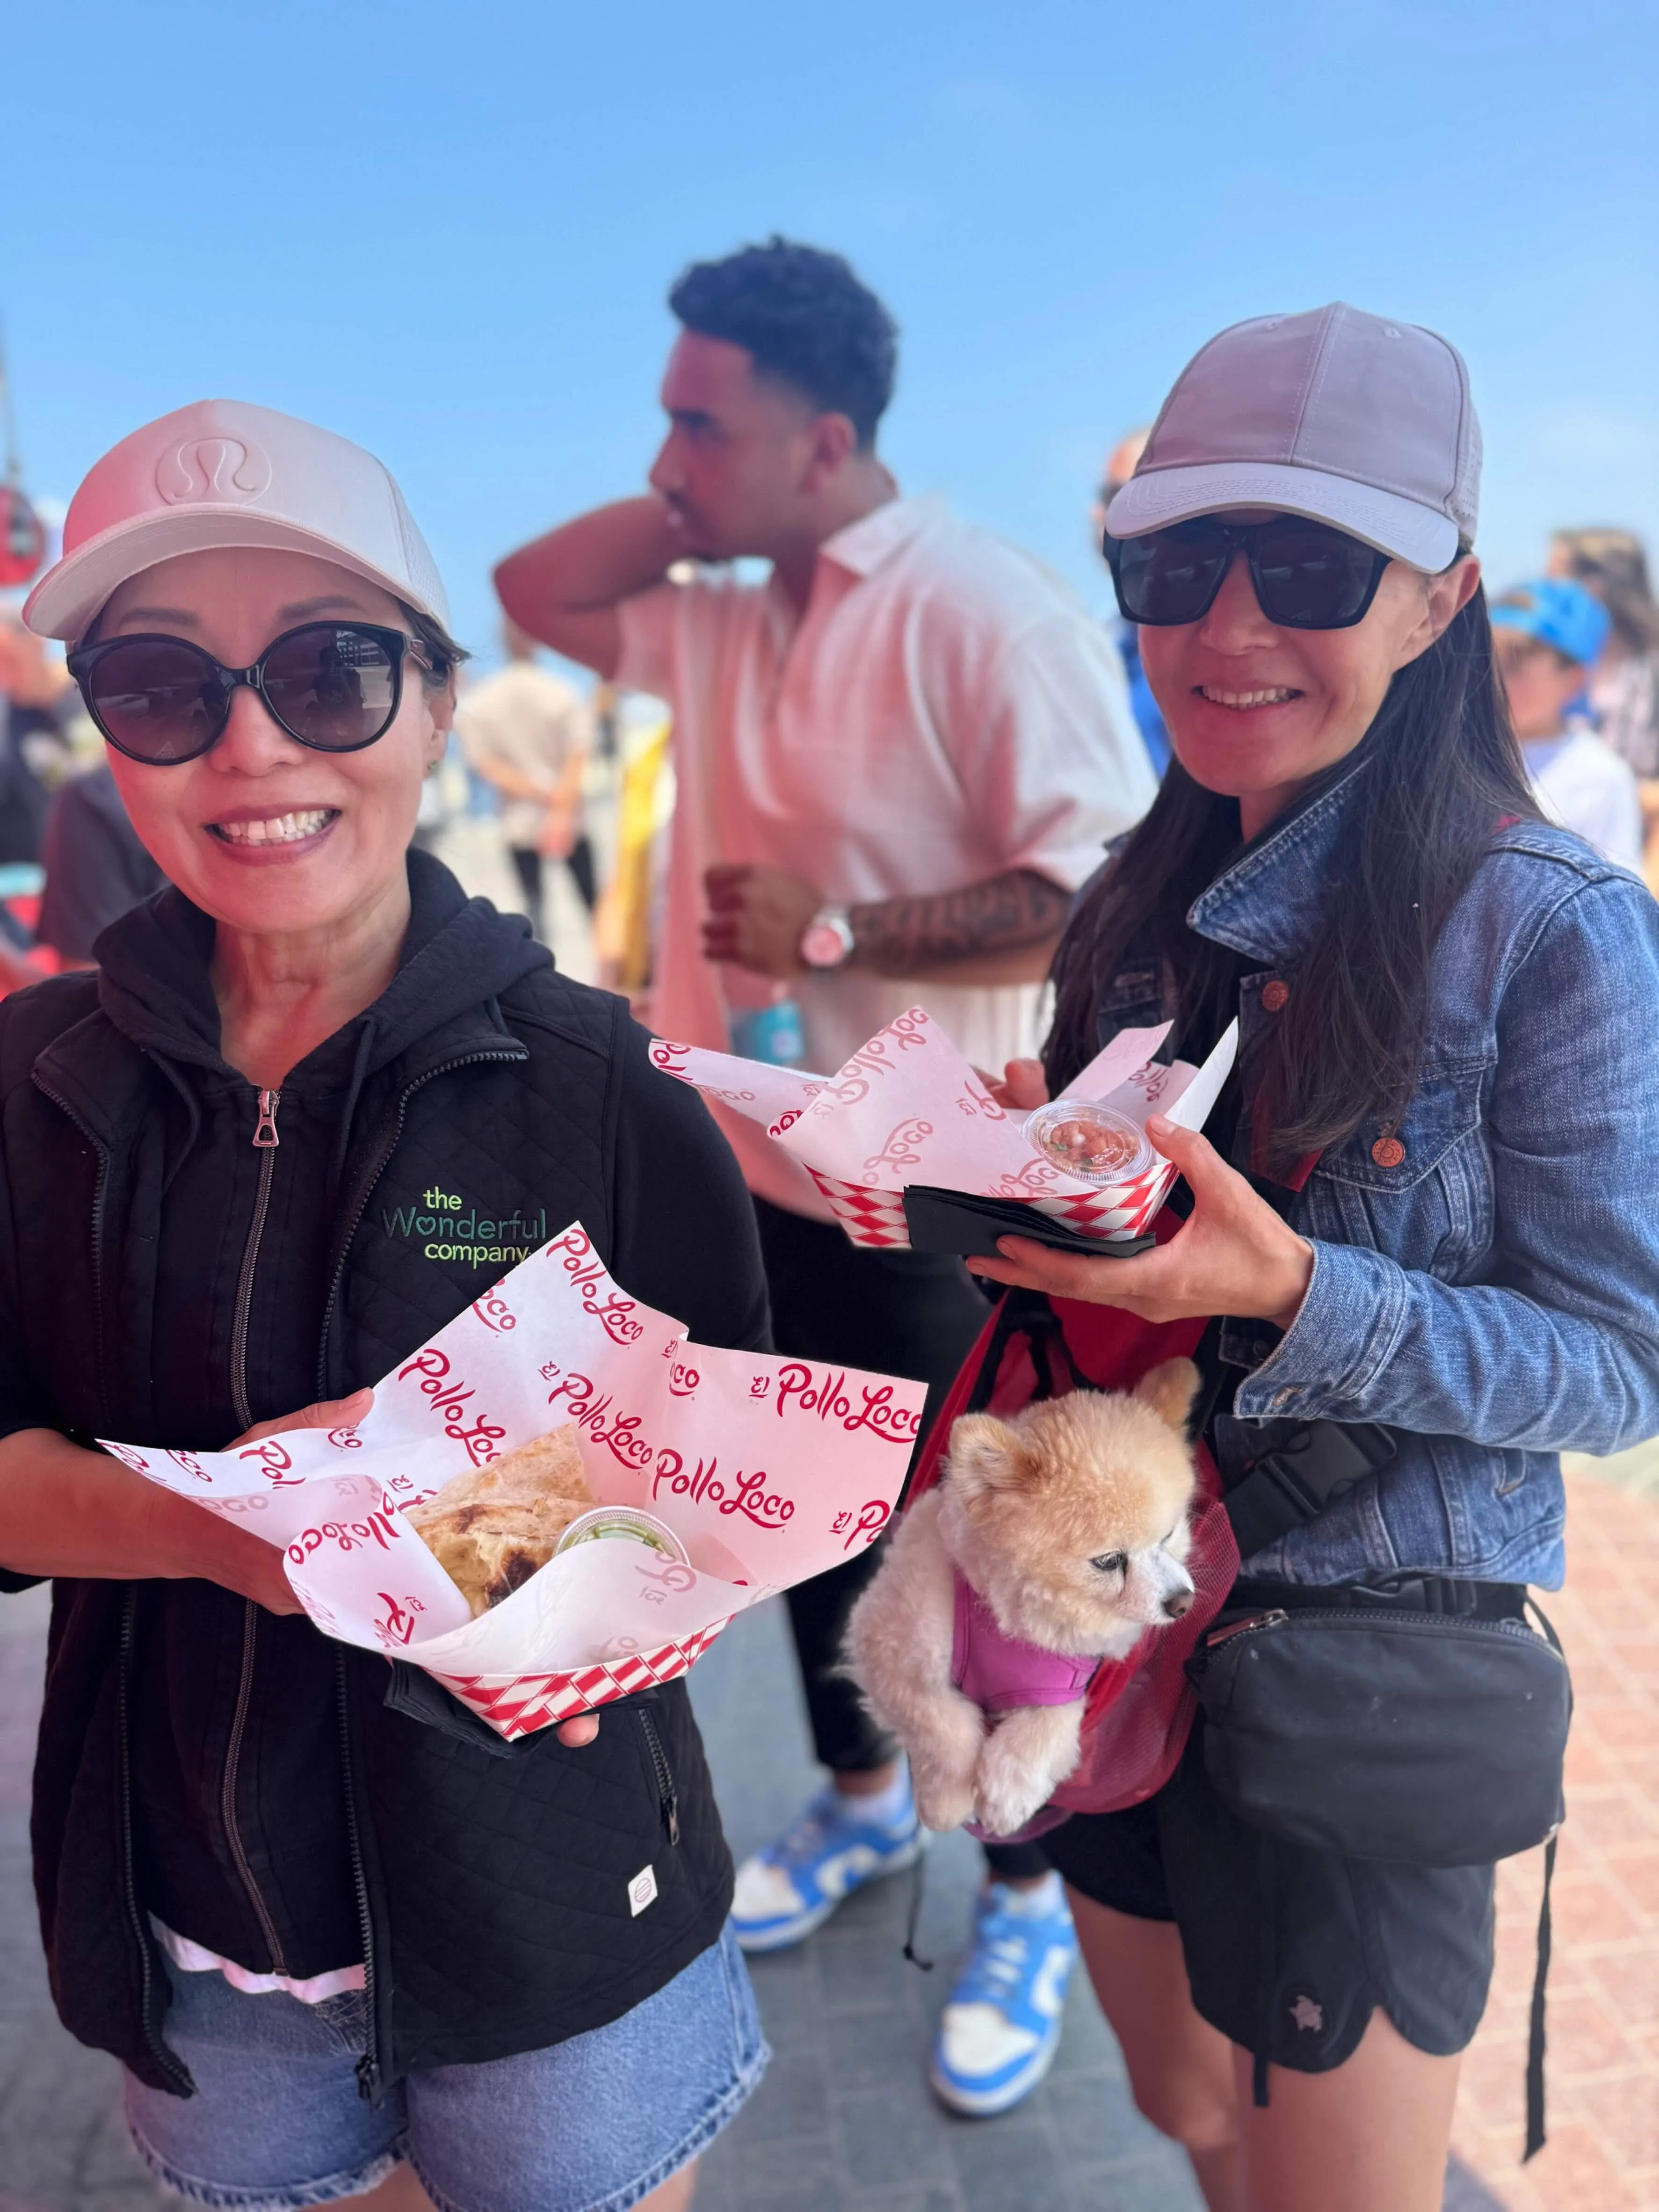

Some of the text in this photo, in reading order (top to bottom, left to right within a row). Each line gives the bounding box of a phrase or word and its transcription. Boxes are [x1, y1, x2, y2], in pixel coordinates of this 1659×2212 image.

[380, 1206, 546, 1239] Wonderful
[423, 1186, 462, 1211] the
[424, 1243, 529, 1269] company
[546, 1229, 644, 1345] Pollo Loco
[398, 1349, 476, 1421] Pollo
[749, 1376, 770, 1398] El
[777, 1363, 850, 1421] Pollo
[548, 1373, 613, 1429] Pollo
[591, 1411, 653, 1470] Loco
[653, 1449, 795, 1529] Pollo Loco
[828, 1511, 852, 1534] El
